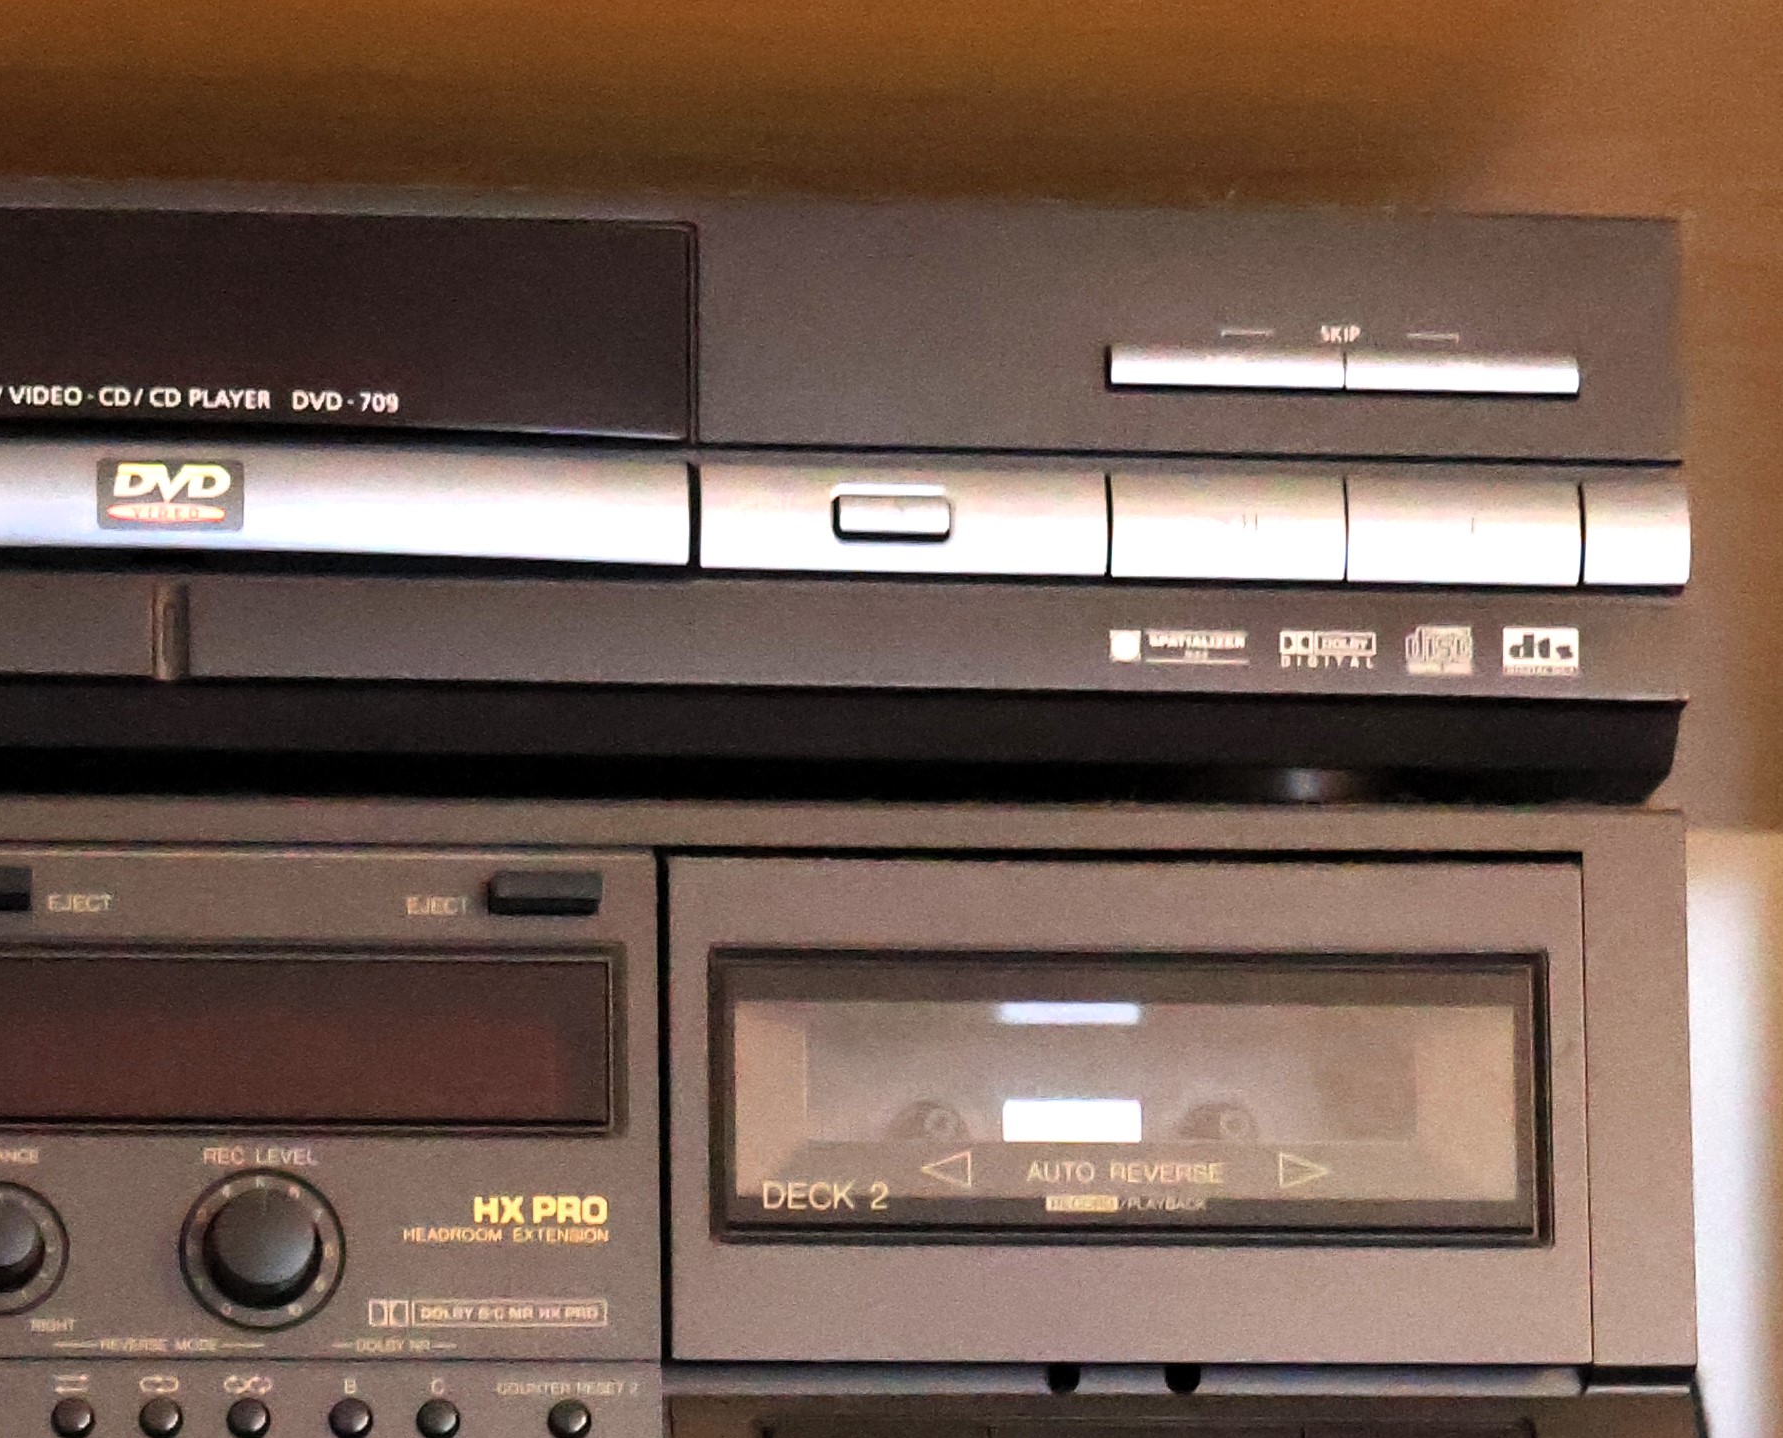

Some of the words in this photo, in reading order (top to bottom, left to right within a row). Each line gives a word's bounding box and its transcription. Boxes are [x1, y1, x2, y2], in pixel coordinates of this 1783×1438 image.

[1320, 325, 1361, 343] SKIP
[190, 389, 271, 410] PLAYER
[113, 462, 231, 501] DVD
[49, 895, 111, 912] EJECT
[407, 897, 468, 915] EJECT
[203, 1147, 245, 1165] REC
[255, 1148, 318, 1166] LEVEL
[1027, 1162, 1096, 1184] AUTO
[1111, 1163, 1224, 1185] REVERSE
[763, 1181, 858, 1210] DECK
[870, 1182, 889, 1210] 2
[474, 1196, 523, 1223] HX
[532, 1197, 608, 1225] PRO
[403, 1229, 503, 1242] HEADROOM
[512, 1229, 609, 1244] EXTENSION
[31, 1318, 78, 1335] RIGHT
[101, 1337, 167, 1352] REVERSE
[174, 1338, 218, 1352] MODE
[345, 1378, 357, 1394] B
[431, 1378, 445, 1395] C
